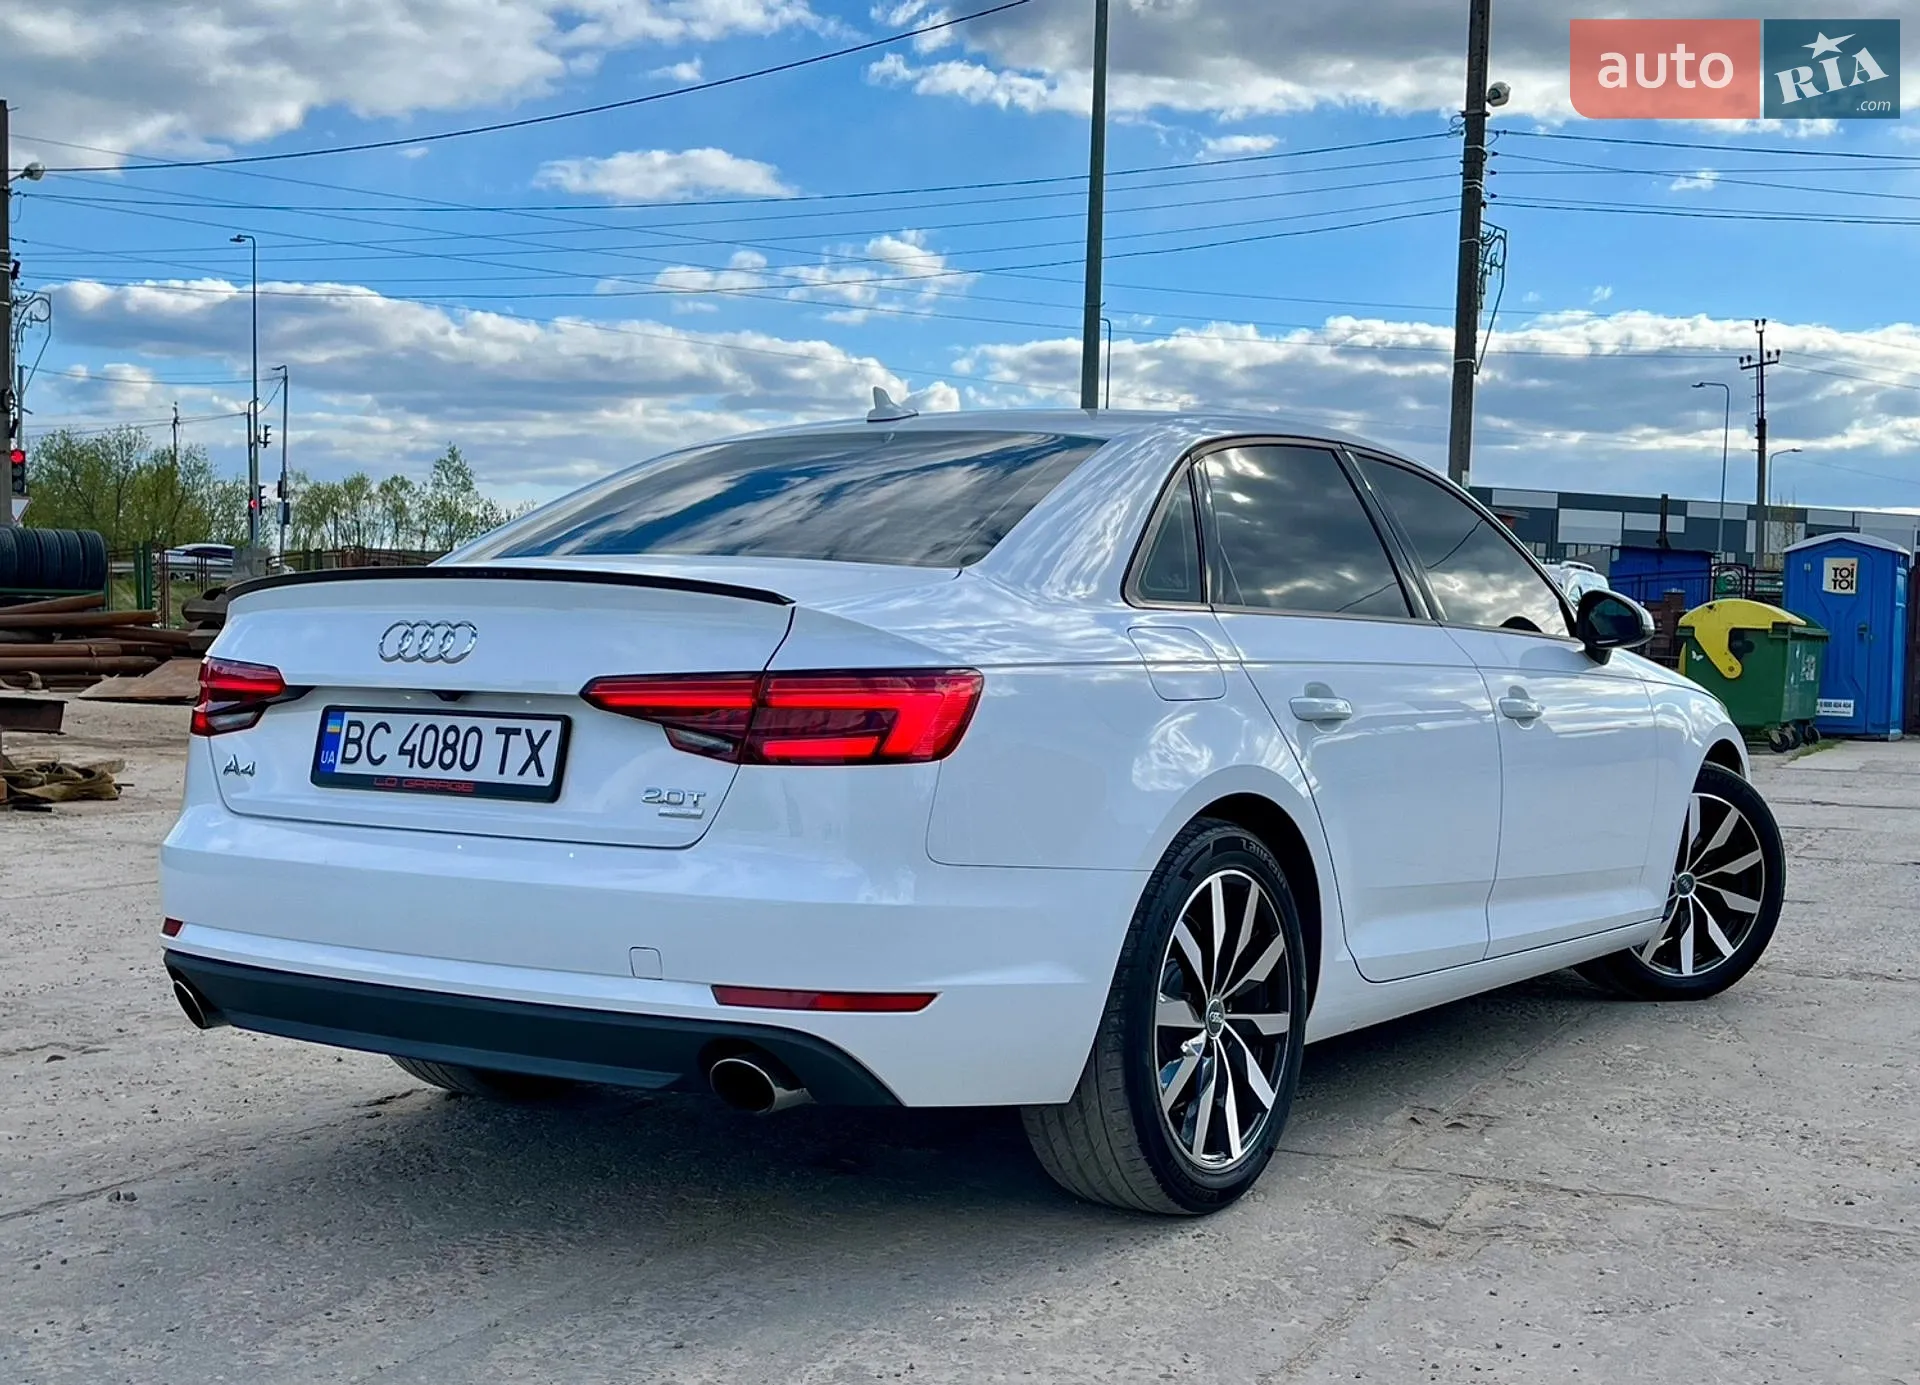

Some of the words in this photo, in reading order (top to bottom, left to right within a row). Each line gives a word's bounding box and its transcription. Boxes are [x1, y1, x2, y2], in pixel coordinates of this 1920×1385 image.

[320, 751, 335, 765] UA
[341, 720, 391, 766] BC
[398, 723, 483, 772] 4080
[495, 727, 552, 777] TX
[223, 753, 255, 777] A4
